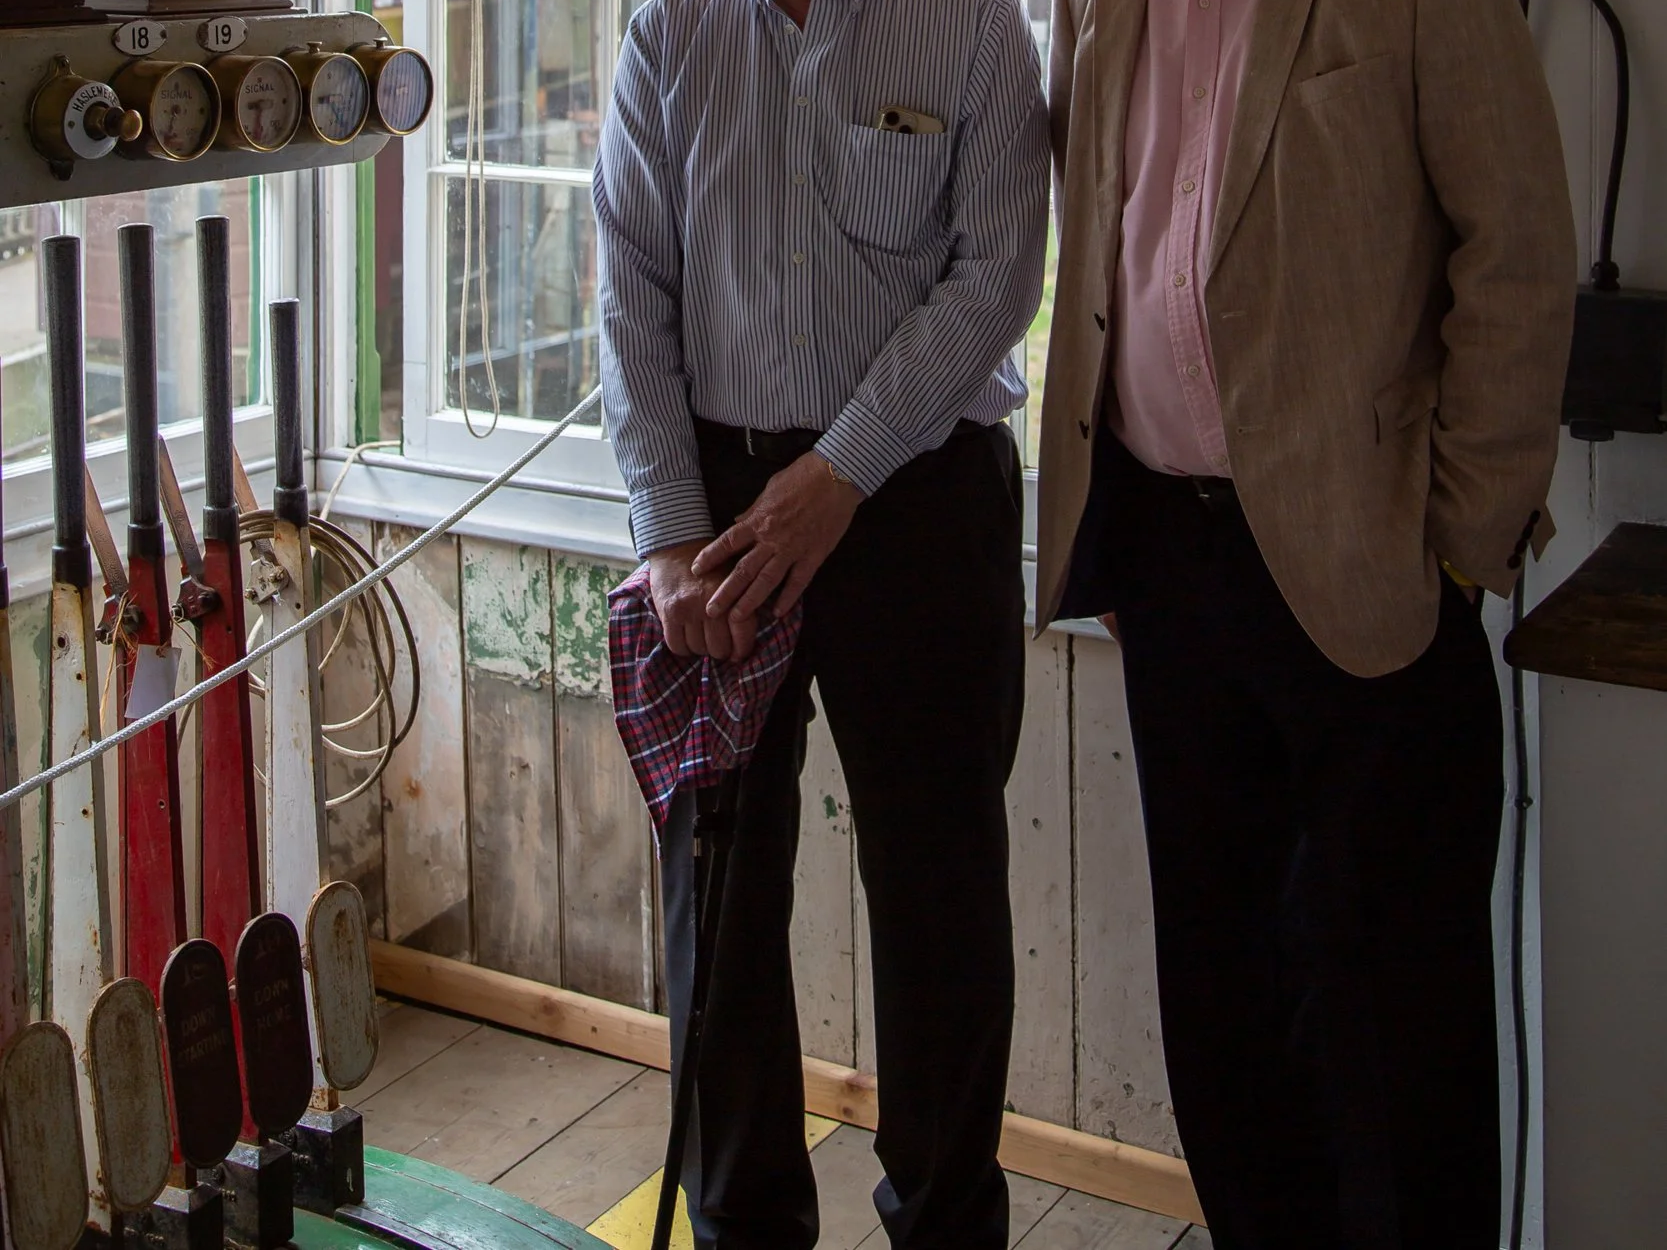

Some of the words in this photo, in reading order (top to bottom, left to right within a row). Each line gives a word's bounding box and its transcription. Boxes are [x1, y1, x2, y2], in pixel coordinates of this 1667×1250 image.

[131, 26, 149, 49] 18
[215, 24, 232, 45] 19
[72, 86, 118, 112] HASLEMERE
[161, 89, 193, 100] SIGNAL
[245, 83, 274, 94] SIGNAL
[255, 978, 288, 1006] DOWN
[182, 1006, 215, 1036] DOWN
[257, 1004, 290, 1032] HOME
[176, 1027, 228, 1065] STARTIN
